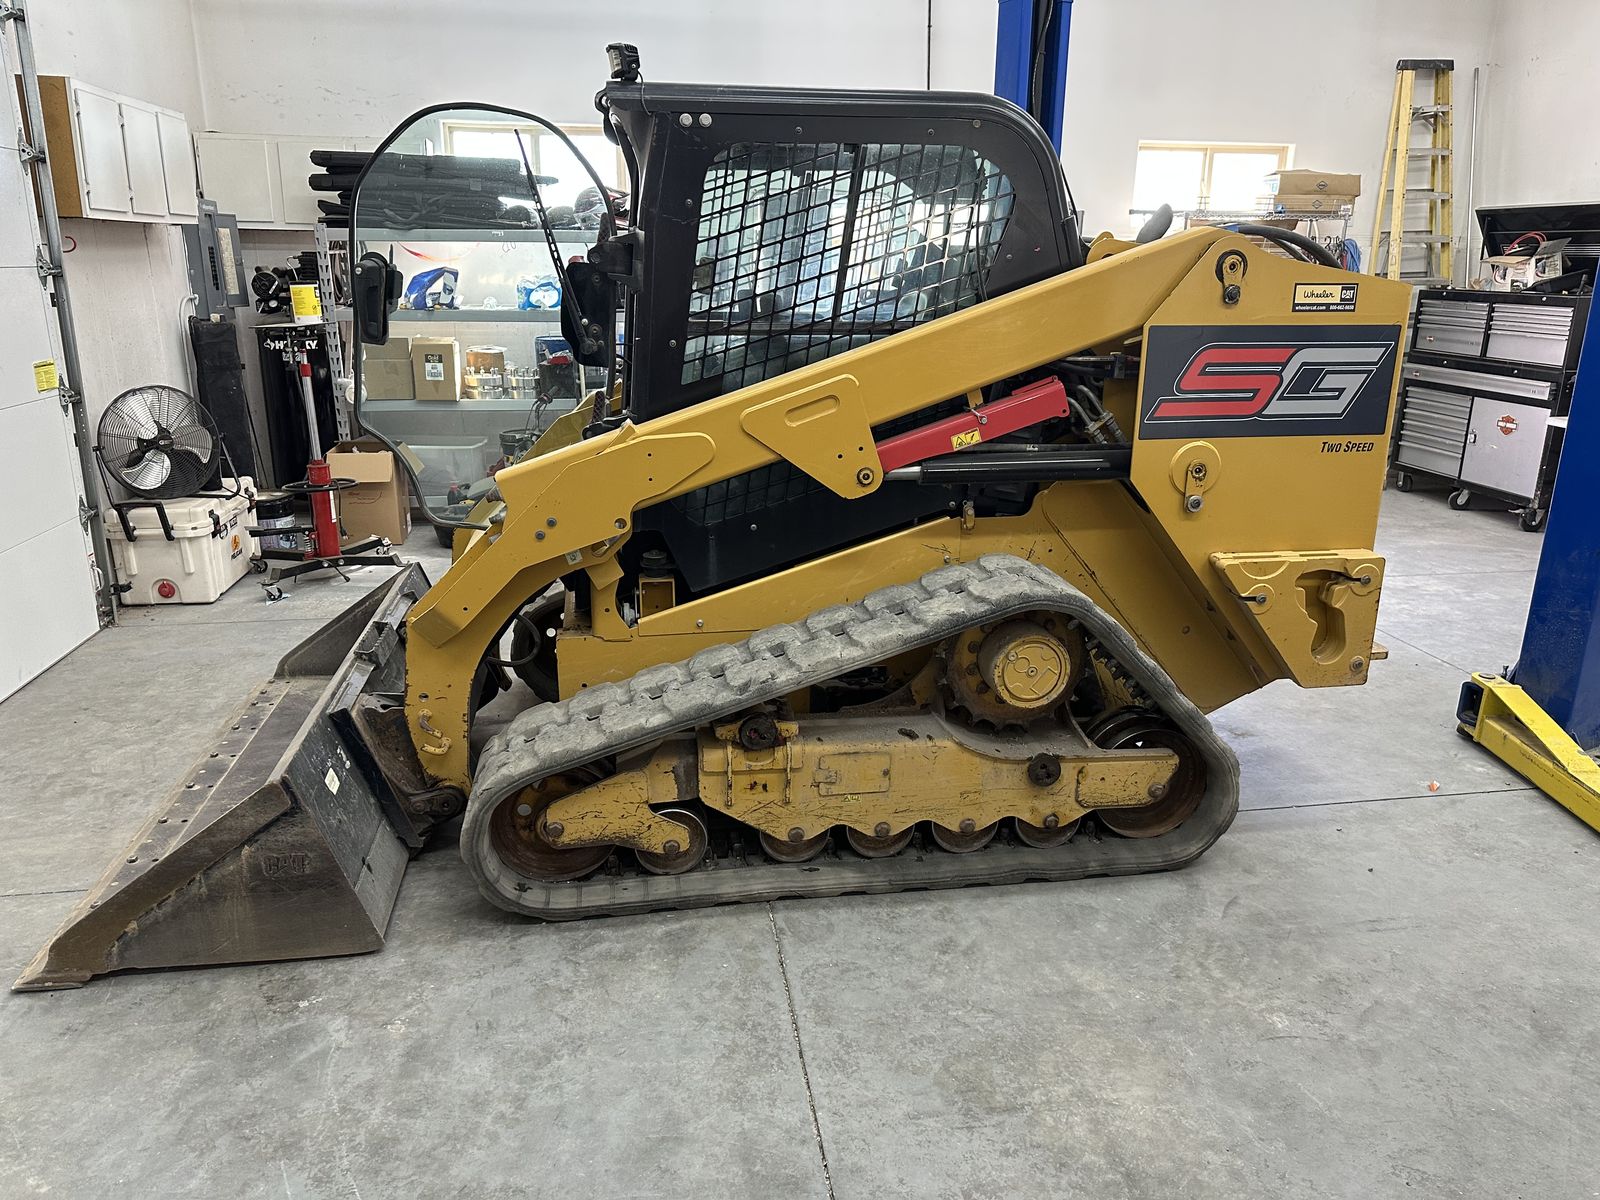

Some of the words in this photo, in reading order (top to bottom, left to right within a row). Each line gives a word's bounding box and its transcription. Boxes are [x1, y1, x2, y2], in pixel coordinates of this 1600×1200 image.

[1303, 290, 1335, 299] Wheeler
[1341, 290, 1354, 299] CAT
[1145, 342, 1394, 423] SG
